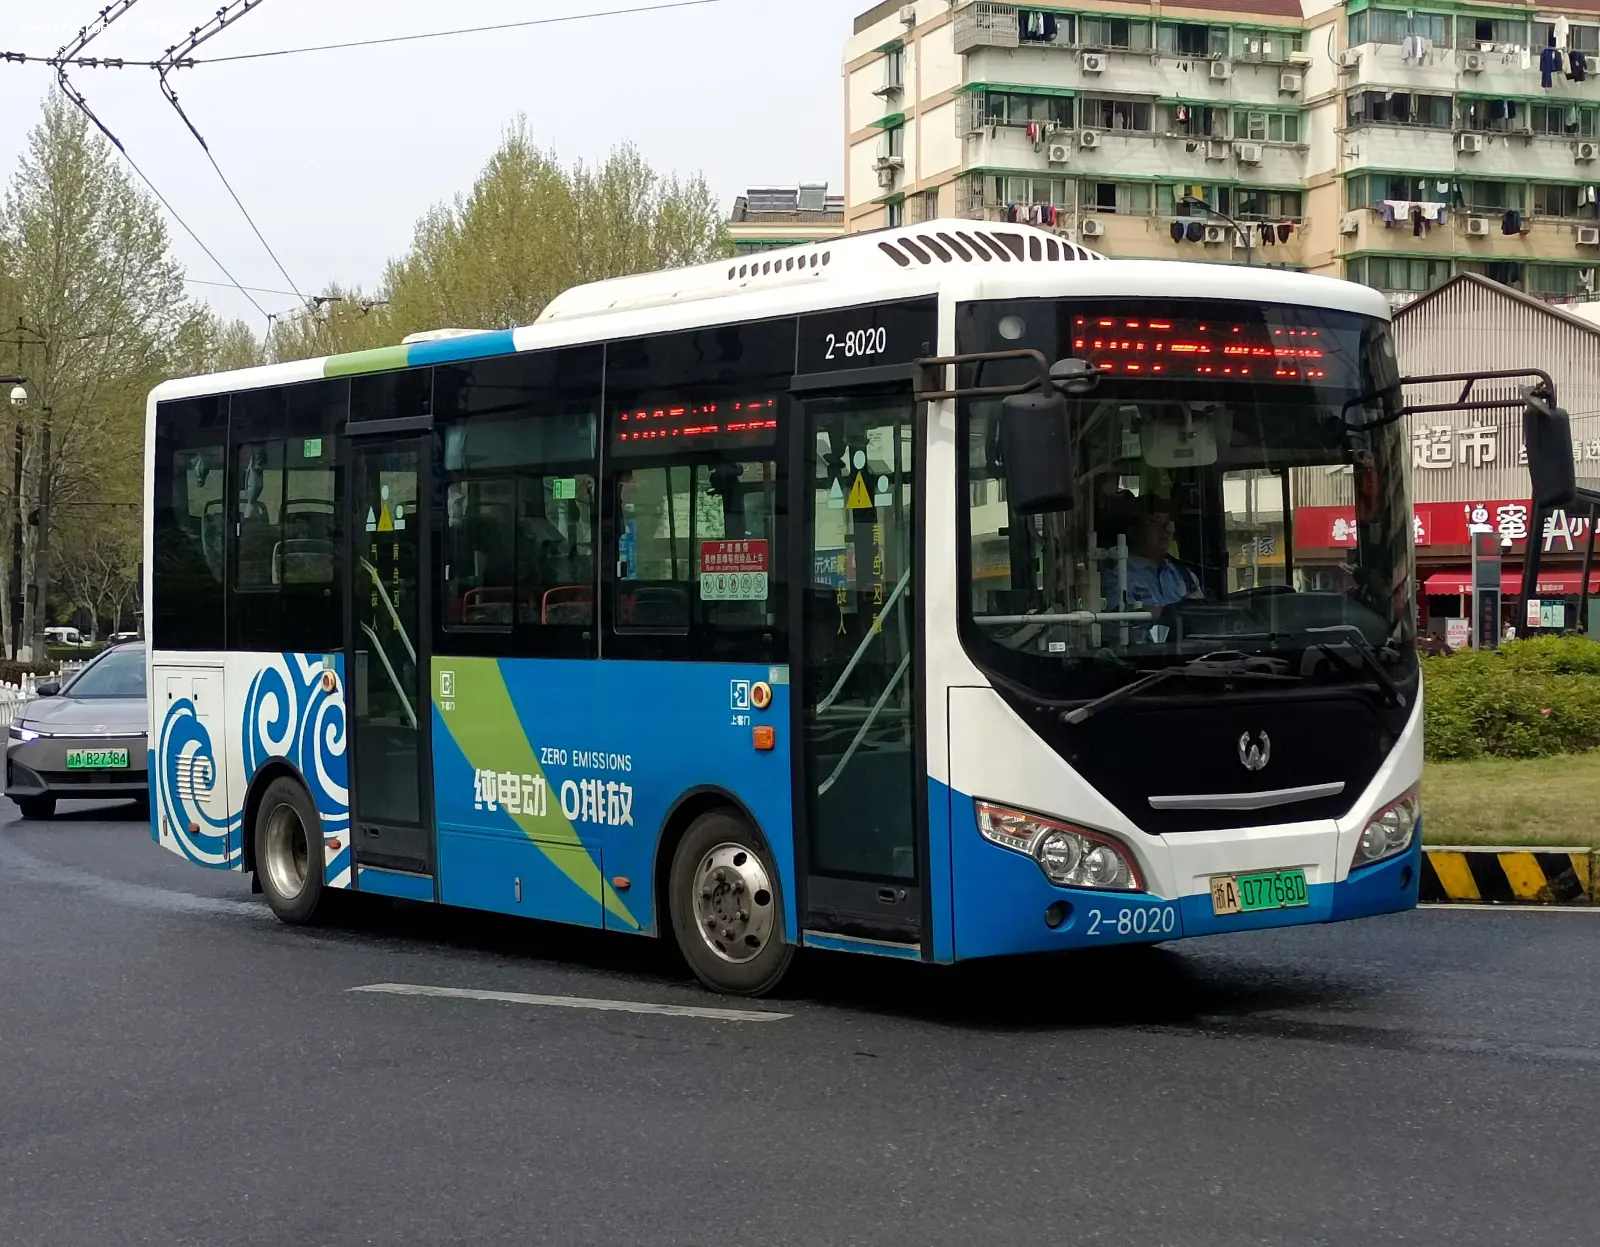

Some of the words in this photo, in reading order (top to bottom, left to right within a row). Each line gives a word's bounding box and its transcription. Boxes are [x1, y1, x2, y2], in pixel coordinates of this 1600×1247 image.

[825, 326, 887, 360] 2-8020
[1413, 421, 1498, 468] 超市
[1496, 503, 1528, 539] 蜜
[1544, 509, 1574, 551] A
[541, 747, 568, 766] ZERO
[572, 750, 632, 772] EMISSIONS
[473, 768, 547, 817] 纯电动
[1086, 906, 1176, 936] 2-8020
